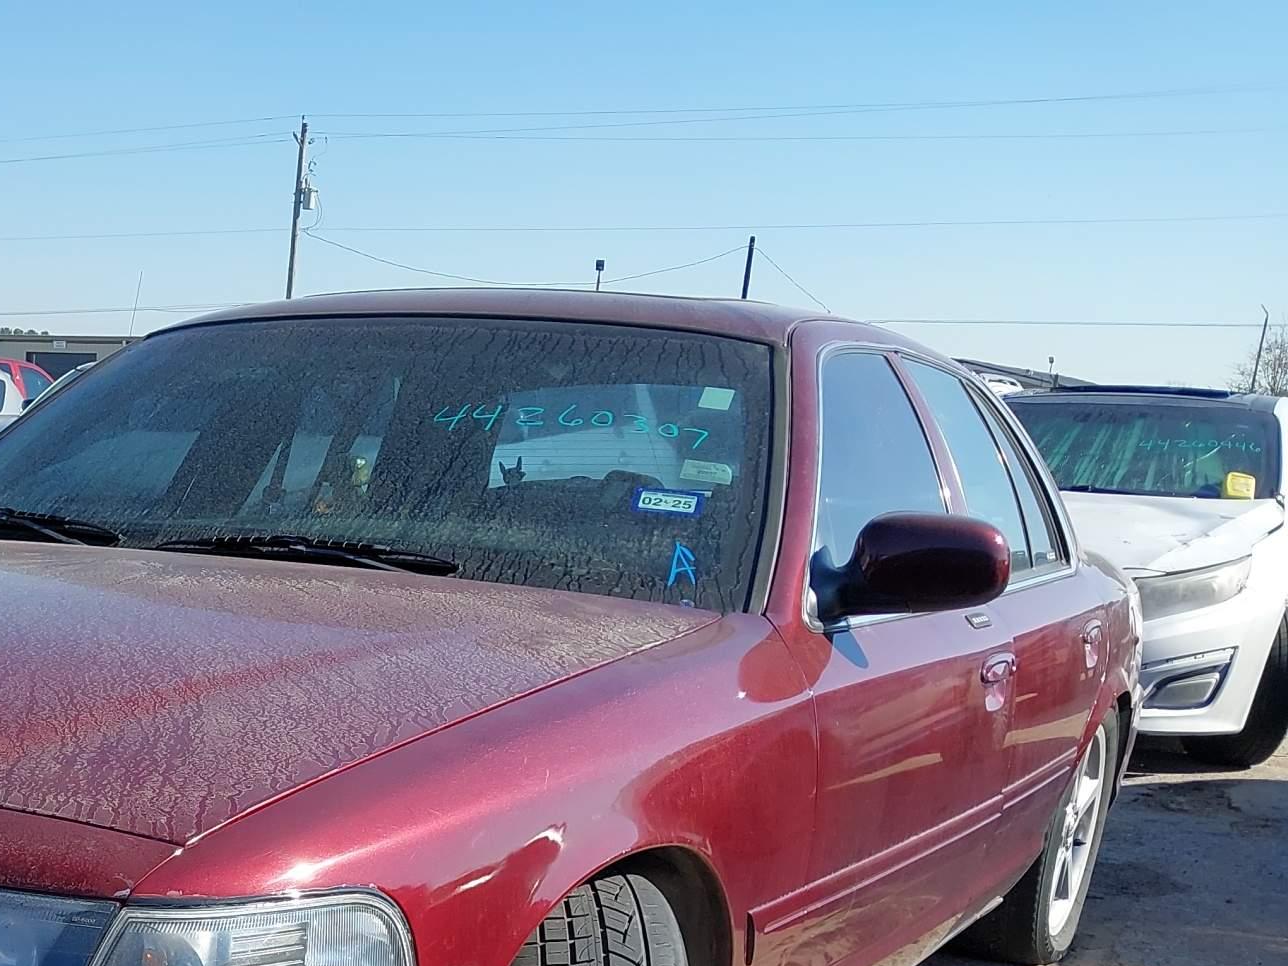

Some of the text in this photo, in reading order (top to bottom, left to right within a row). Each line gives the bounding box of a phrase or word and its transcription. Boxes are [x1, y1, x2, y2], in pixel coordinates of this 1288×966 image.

[434, 404, 709, 449] 44260307
[642, 496, 692, 510] 02 25
